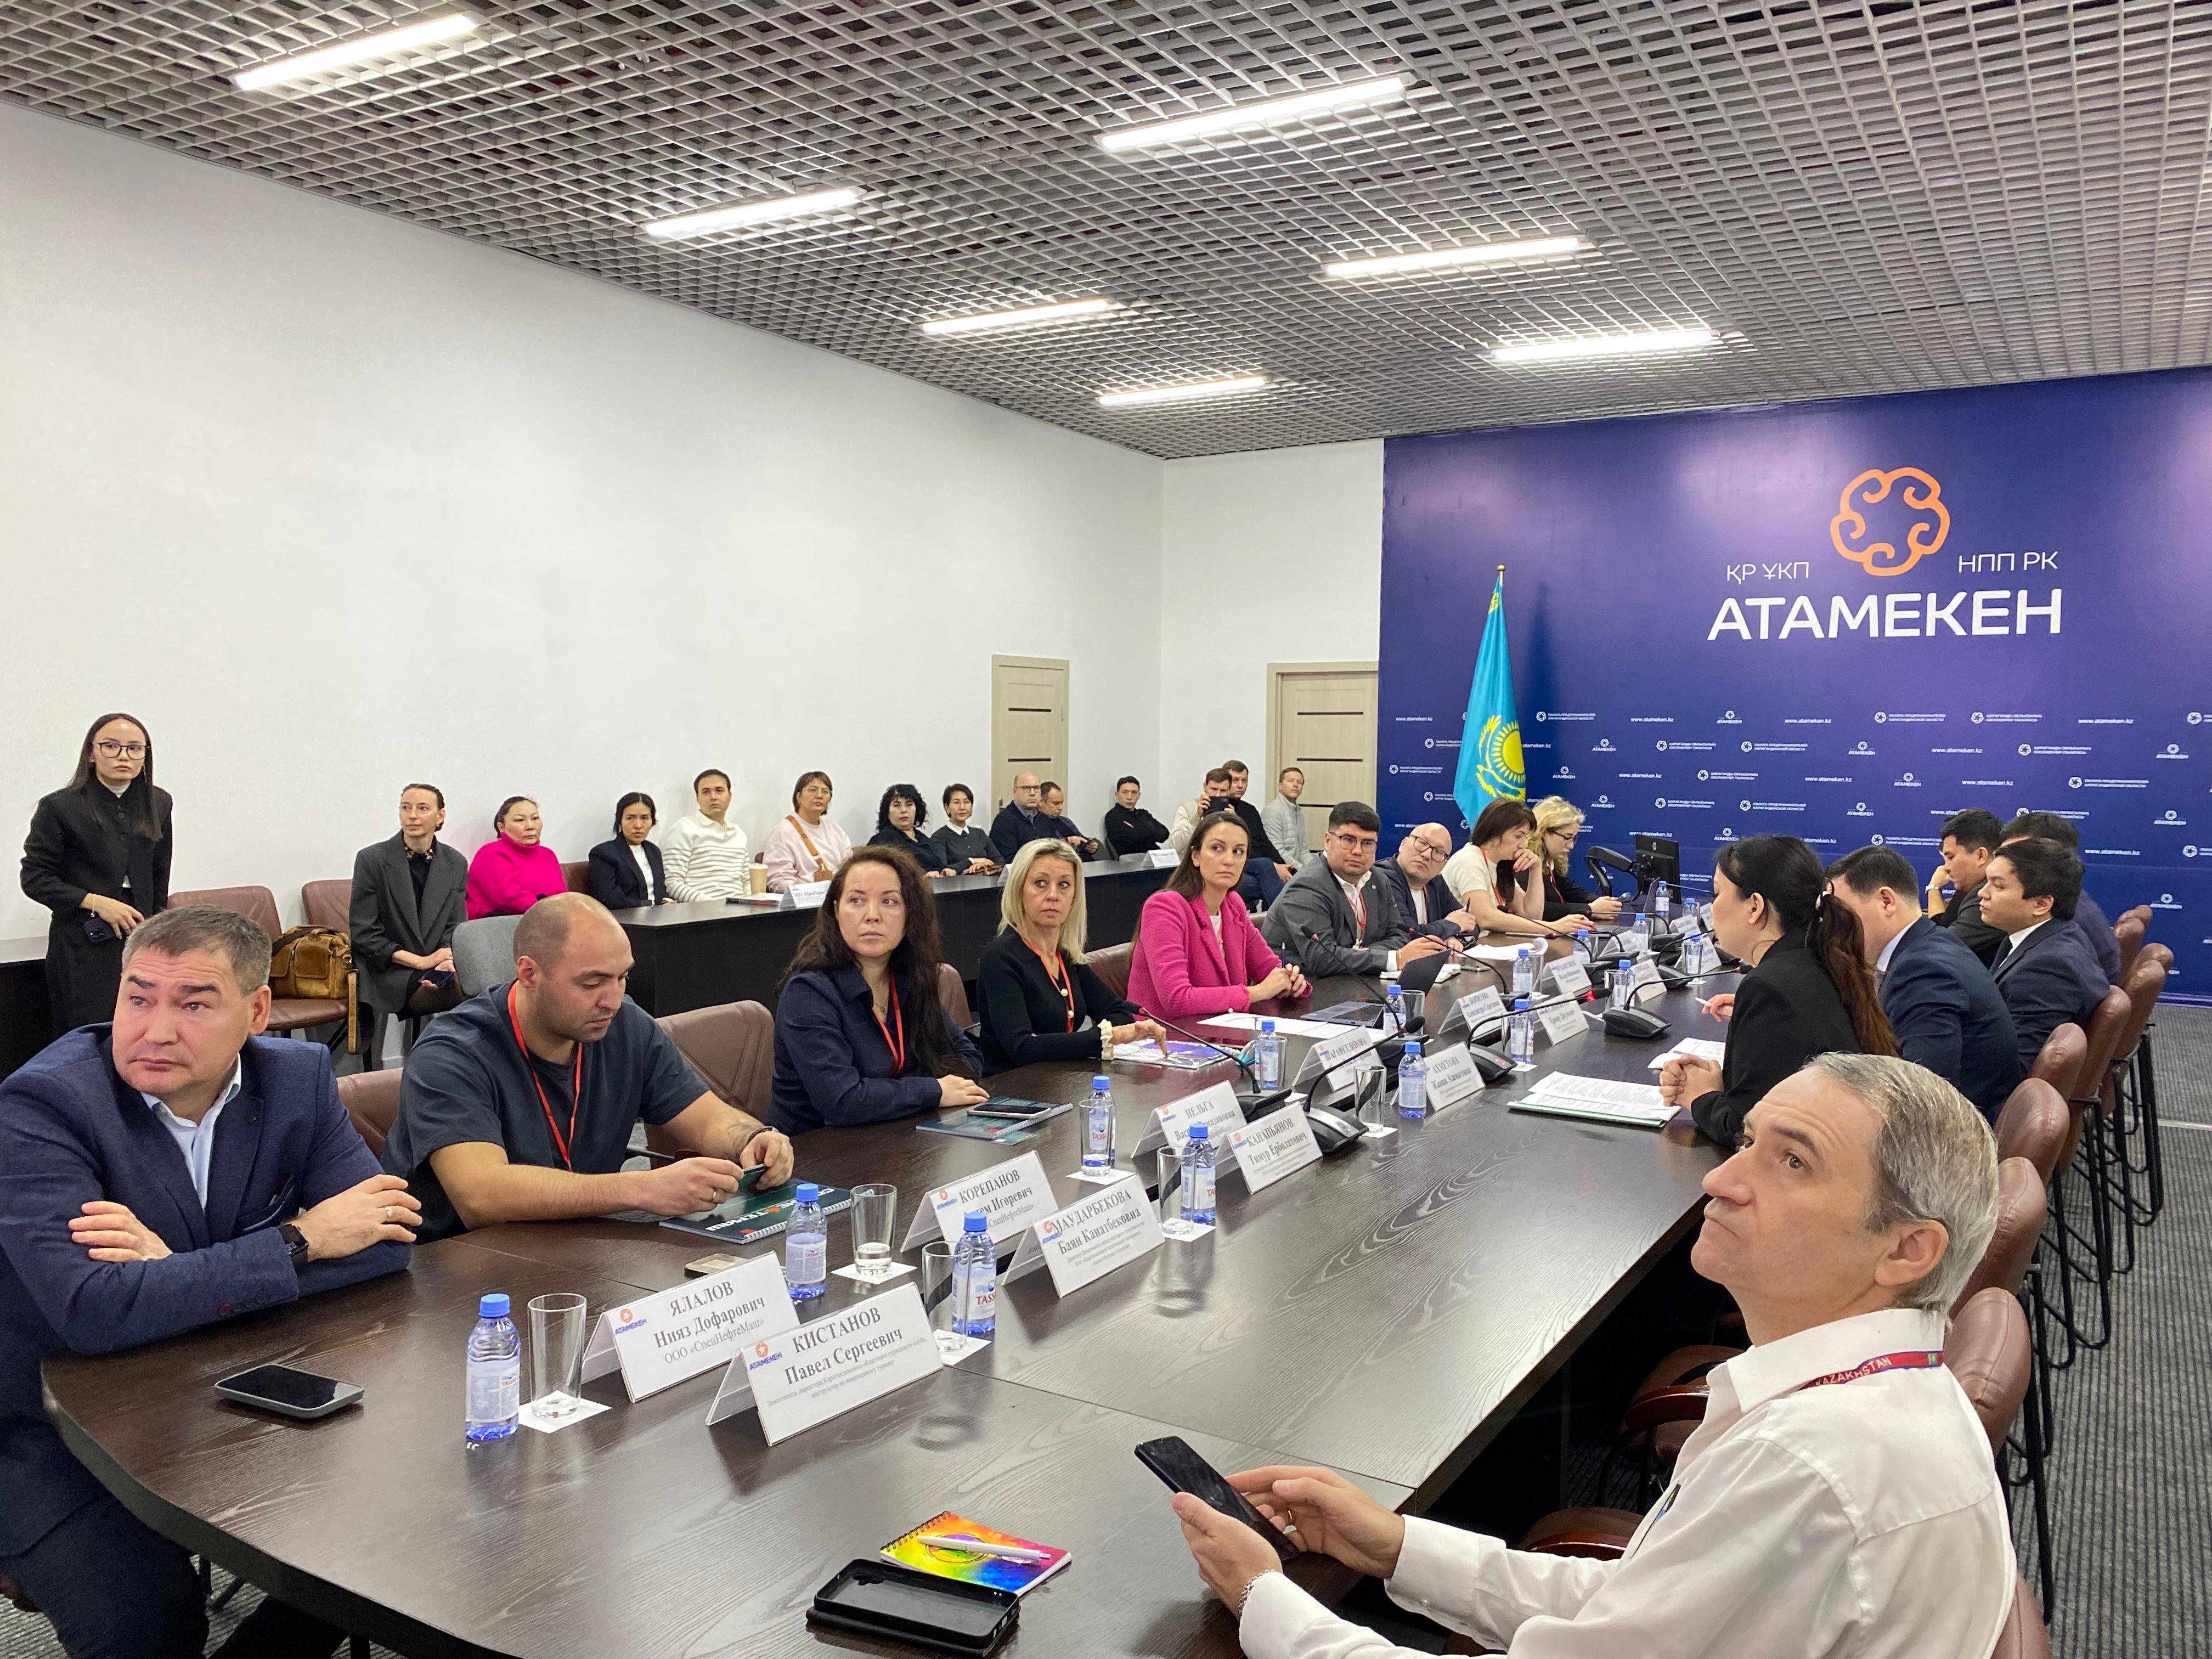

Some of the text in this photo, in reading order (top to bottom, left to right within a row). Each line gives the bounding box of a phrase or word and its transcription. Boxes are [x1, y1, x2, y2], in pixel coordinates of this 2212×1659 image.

[1726, 563, 1756, 585] ҚР
[1958, 551, 2058, 573] НПП РК
[1707, 588, 2063, 641] АТАМЕКЕН
[1185, 1101, 1214, 1119] НЕЛЬГА
[1246, 1118, 1294, 1147] КАНАПЬЯНОВ
[1248, 1150, 1271, 1165] Тимур
[959, 1169, 1020, 1204] КОРЕПАНОВ
[991, 1187, 1033, 1212] Игоревич
[1051, 1189, 1132, 1233] МАУДАРБЕКОВА
[1057, 1239, 1082, 1255] Баян
[1081, 1208, 1141, 1240] Канатбековна
[670, 1280, 734, 1317] ЯЛАЛОВ
[614, 1318, 648, 1336] АТАМЕКЕН
[653, 1296, 765, 1349] Нияз Дофарович
[792, 1306, 882, 1354] КИСТАНОВ
[664, 1317, 765, 1364] ООО «СпецНефтеМаш»
[783, 1328, 903, 1385] Павел Сергеевич
[749, 1351, 783, 1372] АТАМЕКЕН
[1815, 1356, 1893, 1387] KAZAKHSTAN
